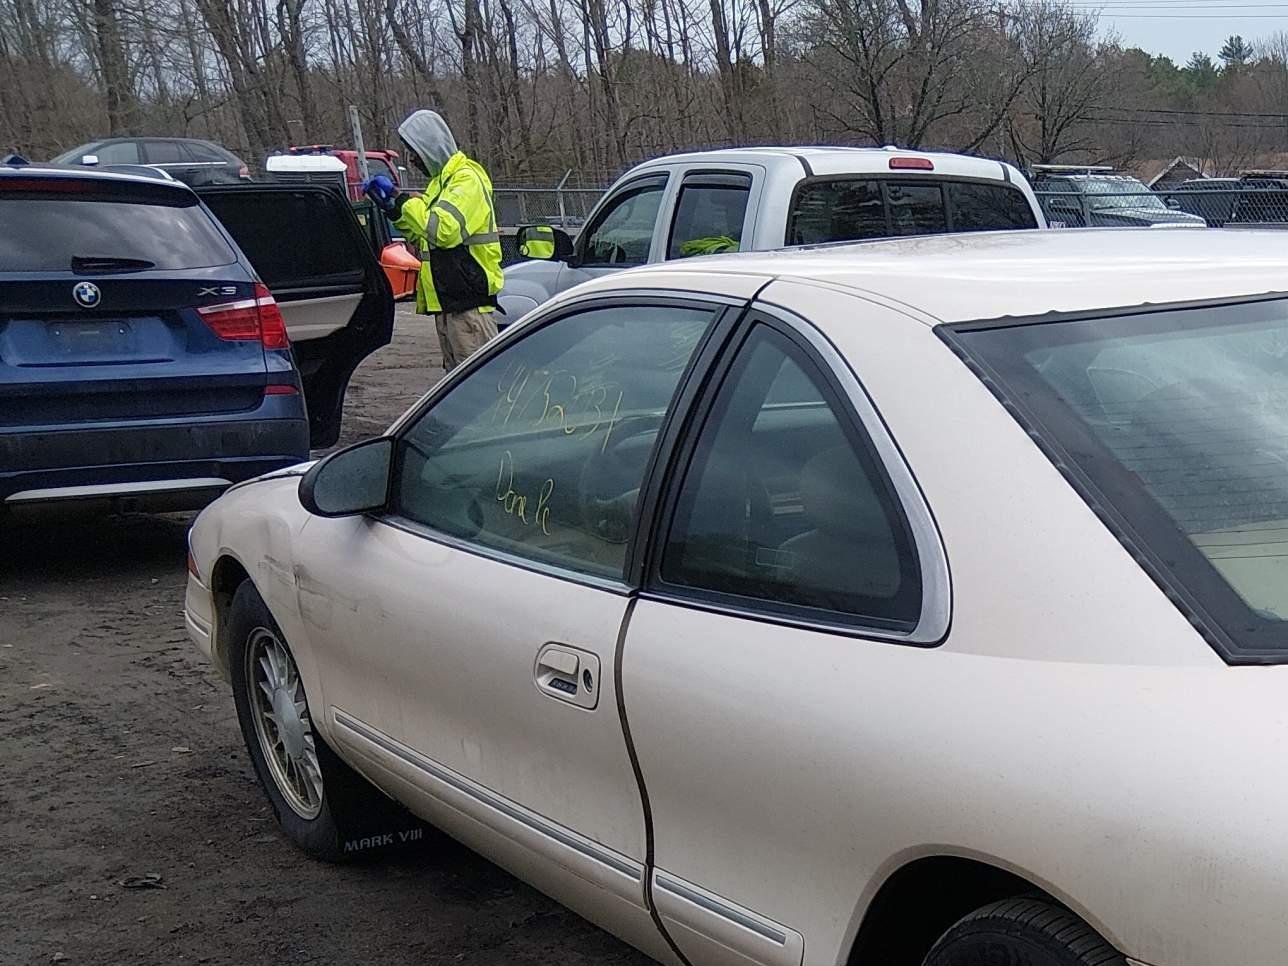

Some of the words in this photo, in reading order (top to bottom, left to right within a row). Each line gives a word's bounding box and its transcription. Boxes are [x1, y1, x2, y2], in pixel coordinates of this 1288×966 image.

[197, 286, 237, 296] X3
[344, 833, 393, 853] MARK
[399, 828, 422, 842] VIII
